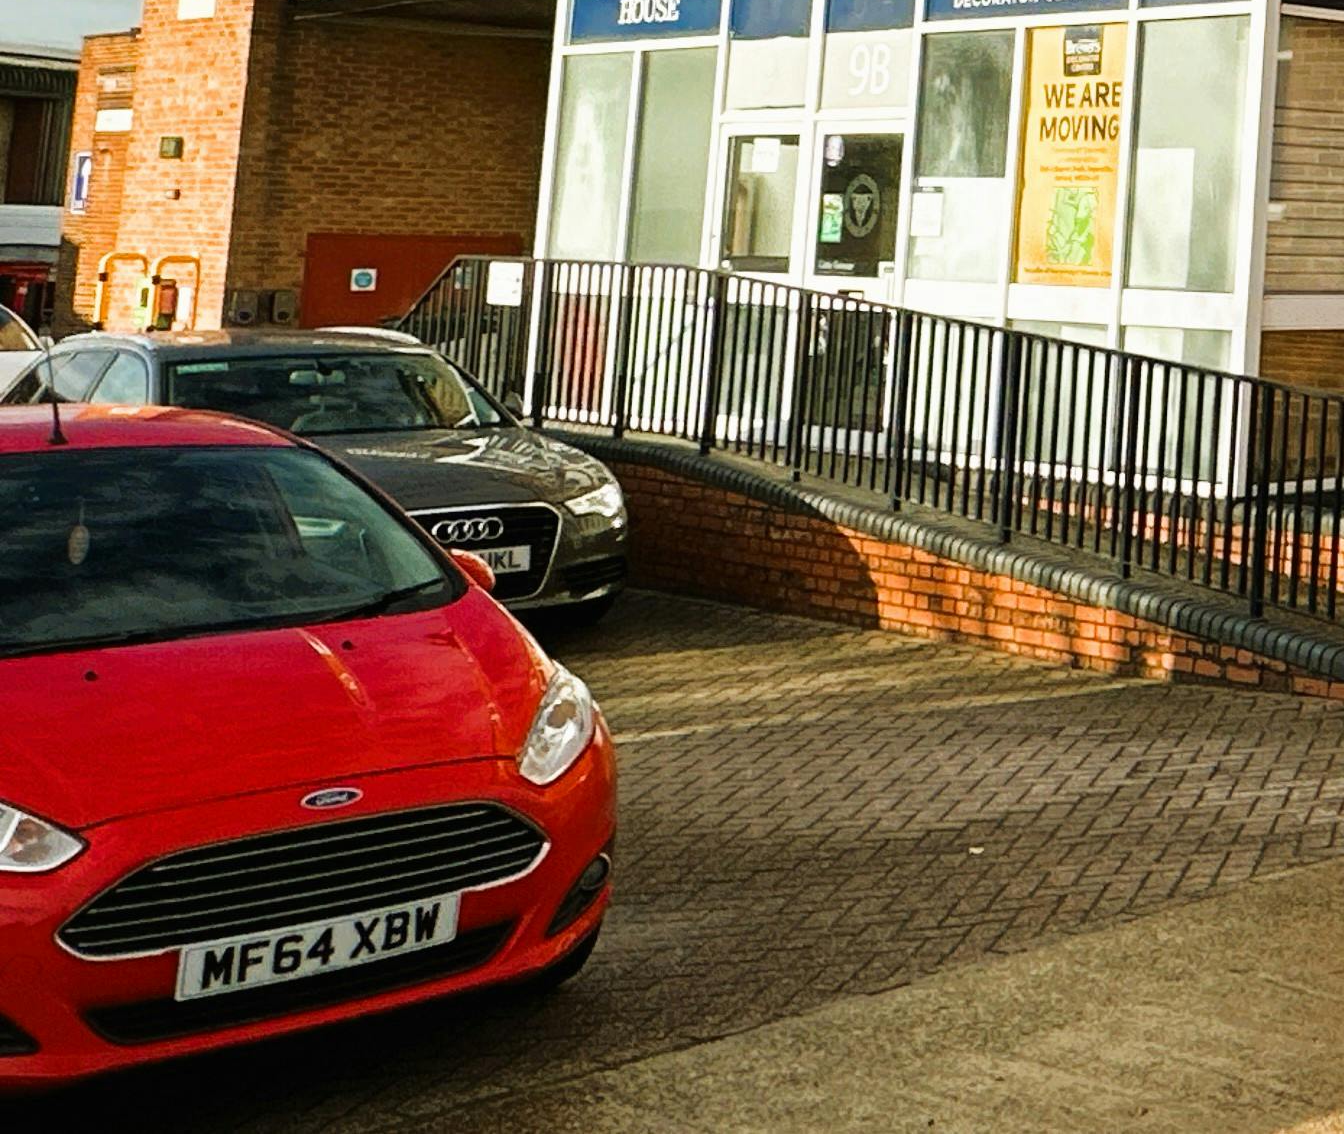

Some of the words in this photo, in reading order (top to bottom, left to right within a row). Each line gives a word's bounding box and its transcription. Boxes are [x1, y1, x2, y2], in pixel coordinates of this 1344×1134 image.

[848, 43, 892, 96] 9B
[1044, 83, 1076, 109] WE
[1079, 81, 1123, 108] ARE
[1039, 115, 1120, 142] MOVING
[202, 927, 335, 990] MF64
[350, 902, 440, 959] XBW
